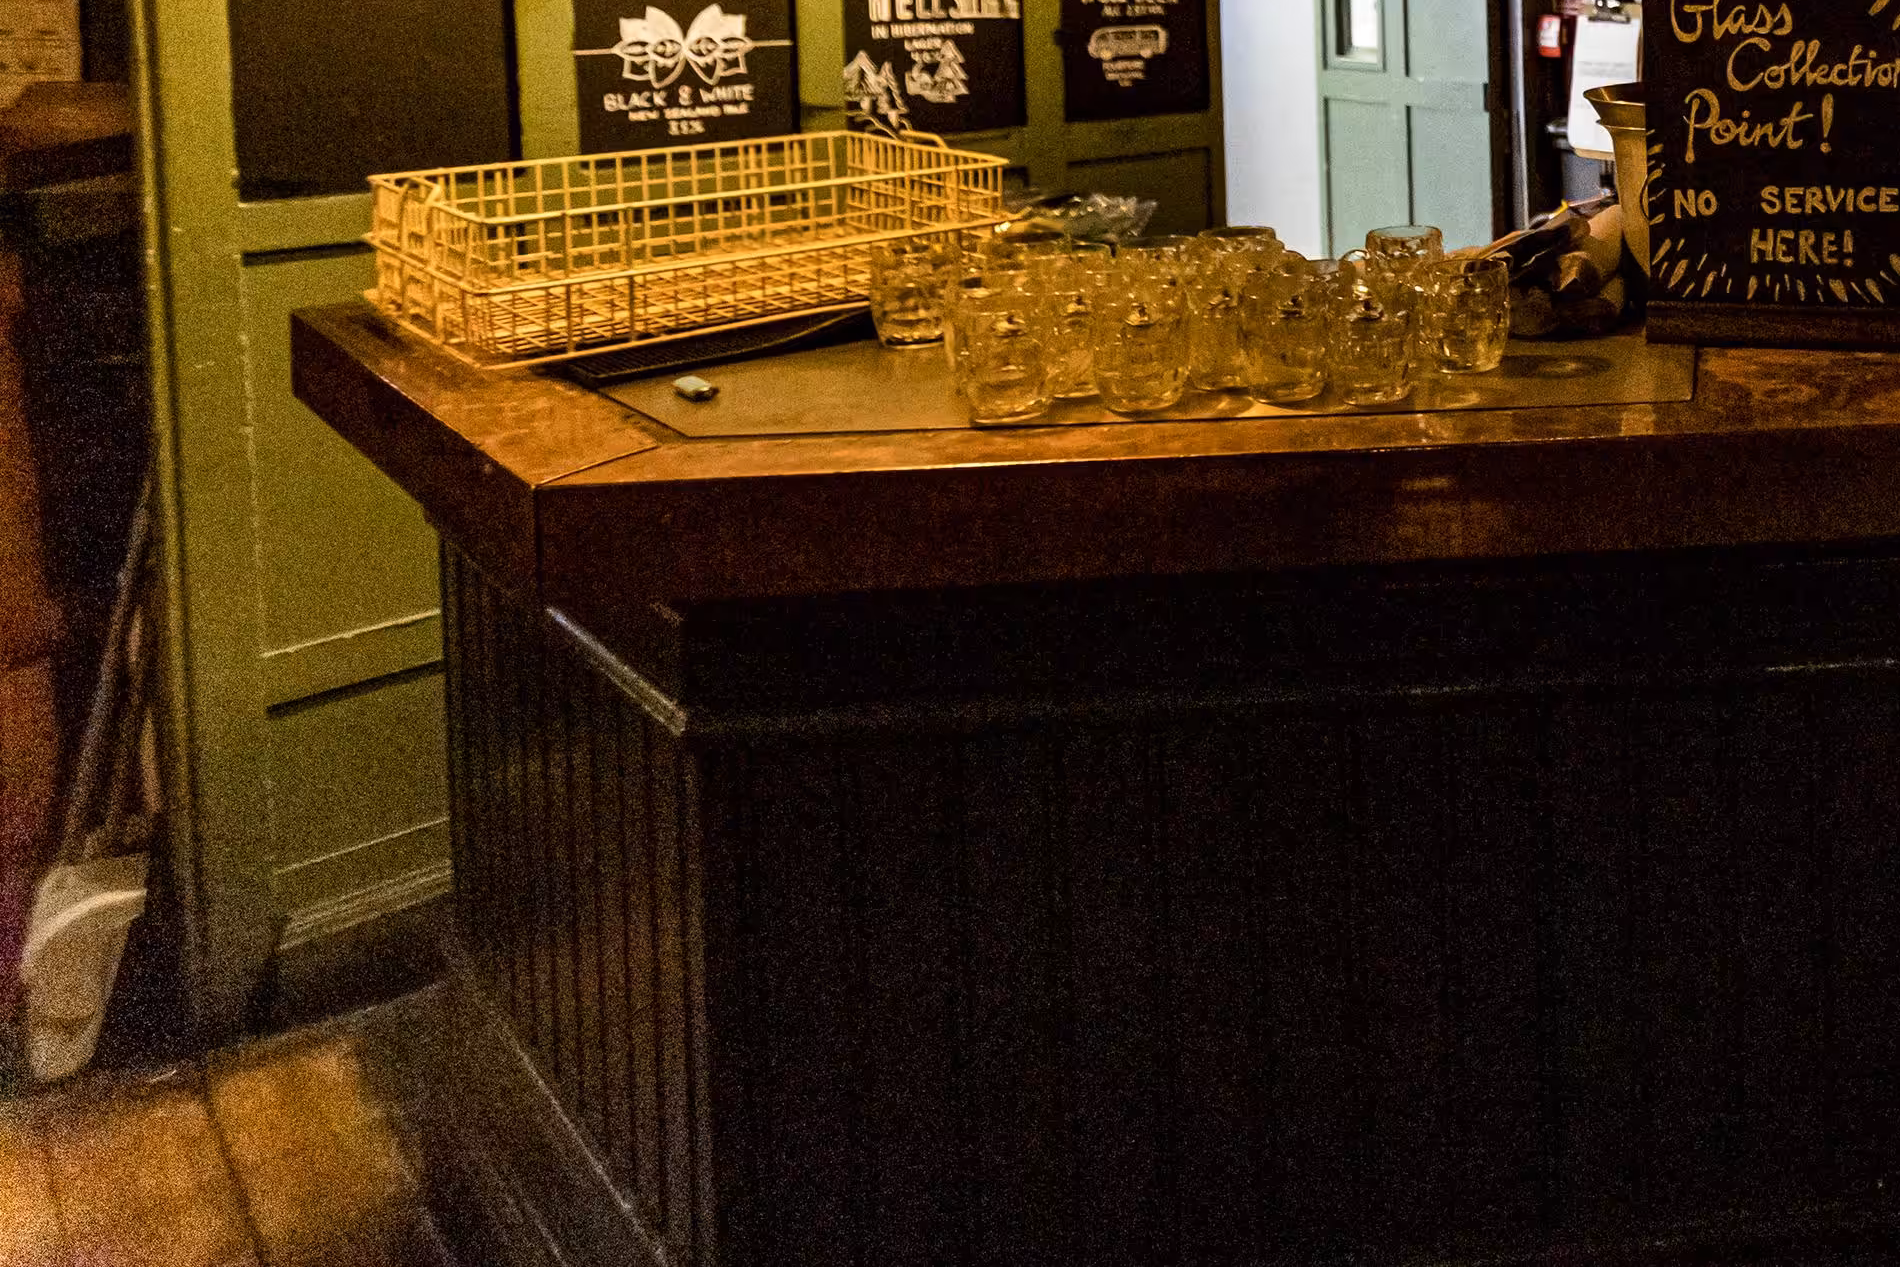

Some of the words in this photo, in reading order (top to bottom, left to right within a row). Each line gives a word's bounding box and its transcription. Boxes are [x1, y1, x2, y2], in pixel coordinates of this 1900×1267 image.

[871, 24, 889, 39] IN
[604, 91, 667, 112] BLACK
[700, 84, 754, 103] WHITE
[1673, 189, 1718, 218] NO
[1760, 185, 1899, 214] SERVICE
[1750, 228, 1853, 266] HERE!
